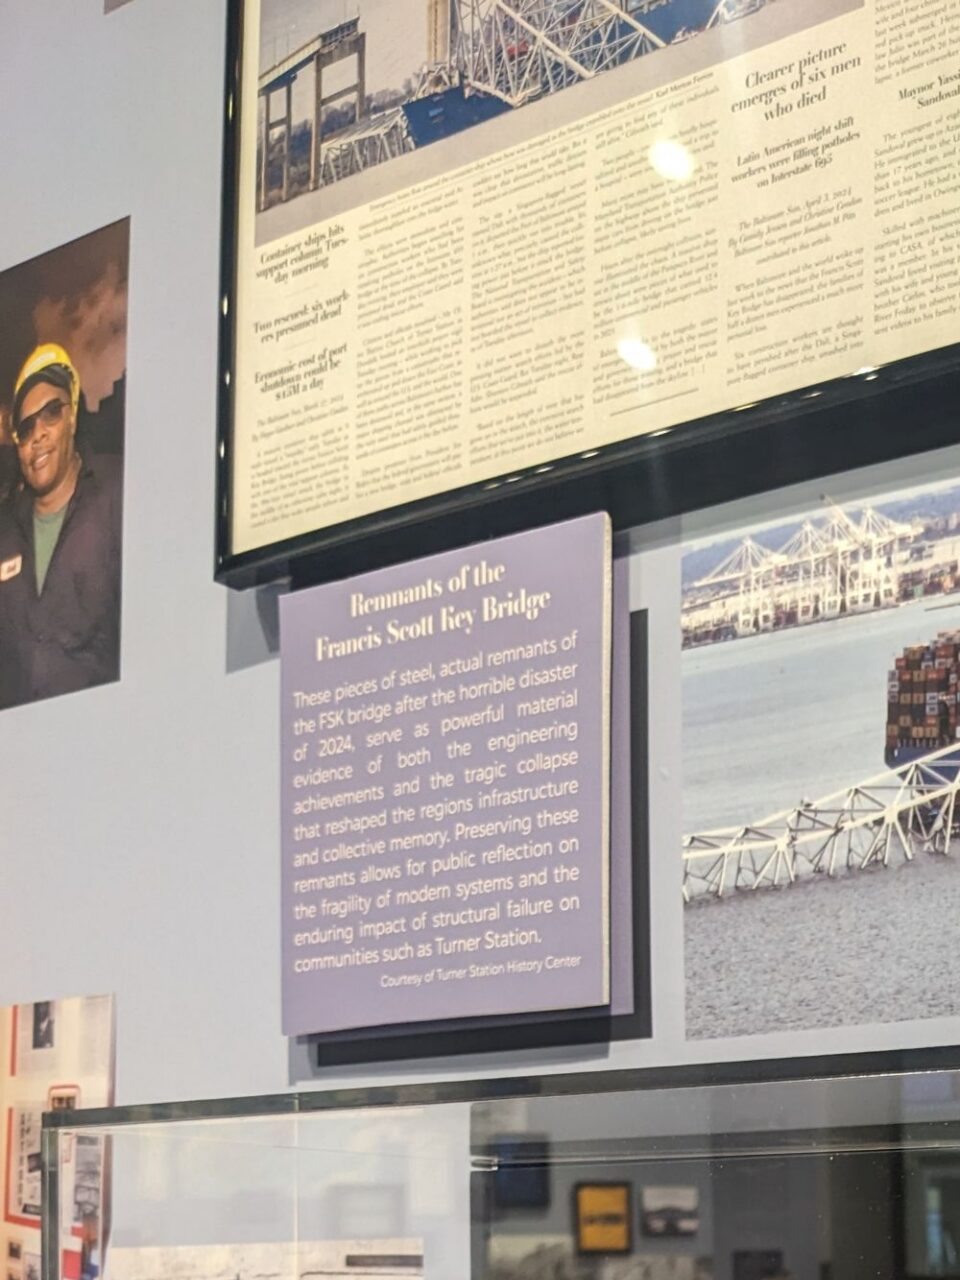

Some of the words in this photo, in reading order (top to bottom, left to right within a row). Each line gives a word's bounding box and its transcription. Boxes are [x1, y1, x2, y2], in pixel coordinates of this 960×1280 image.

[731, 84, 787, 112] emerges
[790, 72, 806, 90] of
[808, 67, 827, 83] six
[831, 56, 861, 76] men
[745, 62, 795, 88] Clearer
[799, 43, 847, 74] picture
[899, 80, 935, 101] Maynor
[764, 102, 793, 121] who
[797, 85, 827, 109] died
[731, 163, 767, 183] workers
[768, 155, 791, 170] were
[793, 145, 820, 163] filling
[821, 131, 861, 154] potholes
[737, 151, 760, 167] Latin
[764, 136, 806, 157] American
[808, 125, 832, 141] night
[834, 116, 854, 132] shift
[757, 176, 769, 188] on
[771, 163, 813, 184] Interstate
[815, 153, 833, 169] 695
[256, 259, 289, 280] support
[290, 247, 323, 266] column
[260, 244, 302, 264] Container
[328, 223, 344, 239] hits
[274, 271, 289, 284] day
[291, 257, 330, 278] morning
[254, 321, 273, 334] Two
[311, 299, 324, 312] six
[260, 333, 275, 344] ers
[275, 311, 319, 343] presumed
[320, 303, 342, 322] dead
[254, 359, 296, 385] Economic
[297, 354, 316, 370] cost
[317, 346, 329, 362] of
[327, 343, 348, 363] port
[260, 374, 302, 394] shutdown
[303, 362, 329, 379] could
[329, 359, 341, 371] be
[351, 578, 443, 618] Remnants
[448, 564, 471, 593] of
[474, 560, 506, 587] the
[316, 626, 383, 662] Francis
[386, 614, 434, 645] Scott
[440, 606, 477, 635] Key
[482, 588, 551, 623] Bridge
[293, 690, 332, 709] These
[335, 680, 378, 704] pieces
[381, 670, 397, 690] of
[400, 663, 436, 687] steel,
[440, 651, 483, 678] actual
[488, 639, 558, 667] remnants
[561, 630, 579, 651] of
[293, 718, 317, 736] the
[319, 710, 345, 730] FSK
[348, 704, 392, 725] bridge
[395, 695, 429, 715] after
[431, 688, 456, 707] the
[459, 674, 516, 701] horrible
[519, 664, 579, 689] disaster
[293, 743, 309, 762] of
[318, 734, 356, 758] 2024,
[366, 728, 403, 748] serve
[414, 723, 430, 739] as
[441, 704, 505, 737] powerful
[517, 688, 578, 717] material
[293, 766, 354, 789] evidence
[367, 754, 383, 775] of
[397, 747, 431, 769] both
[446, 741, 472, 759] the
[487, 721, 578, 753] engineering
[293, 786, 385, 815] achievements
[393, 776, 420, 797] and
[430, 772, 455, 790] the
[464, 760, 507, 785] tragic
[517, 750, 579, 775] collapse
[294, 823, 321, 841] that
[325, 809, 387, 835] reshaped
[392, 806, 416, 824] the
[420, 798, 474, 822] regions
[478, 780, 579, 809] infrastructure
[293, 848, 319, 868] and
[322, 840, 386, 863] collective
[390, 831, 451, 852] memory.
[455, 815, 532, 841] Preserving
[536, 809, 580, 829] these
[294, 872, 356, 893] remnants
[360, 866, 402, 884] allows
[406, 858, 427, 876] for
[432, 850, 477, 877] public
[482, 840, 553, 865] reflection
[558, 838, 579, 854] on
[294, 903, 317, 921] the
[321, 895, 372, 918] fragility
[376, 889, 393, 909] of
[396, 885, 451, 905] modern
[456, 876, 514, 901] systems
[518, 867, 548, 888] and
[553, 864, 580, 883] the
[294, 925, 354, 947] enduring
[360, 917, 407, 940] impact
[412, 912, 428, 931] of
[432, 902, 501, 928] structural
[506, 898, 554, 918] failure
[559, 896, 580, 911] on
[294, 948, 380, 973] communities
[382, 942, 414, 962] such
[417, 944, 433, 958] as
[434, 937, 482, 955] Turner
[484, 928, 542, 950] Station.
[380, 974, 423, 988] Courtesy
[424, 969, 436, 983] of
[436, 968, 468, 981] Turner
[469, 964, 505, 978] Station
[507, 960, 544, 974] History
[545, 956, 582, 969] Center
